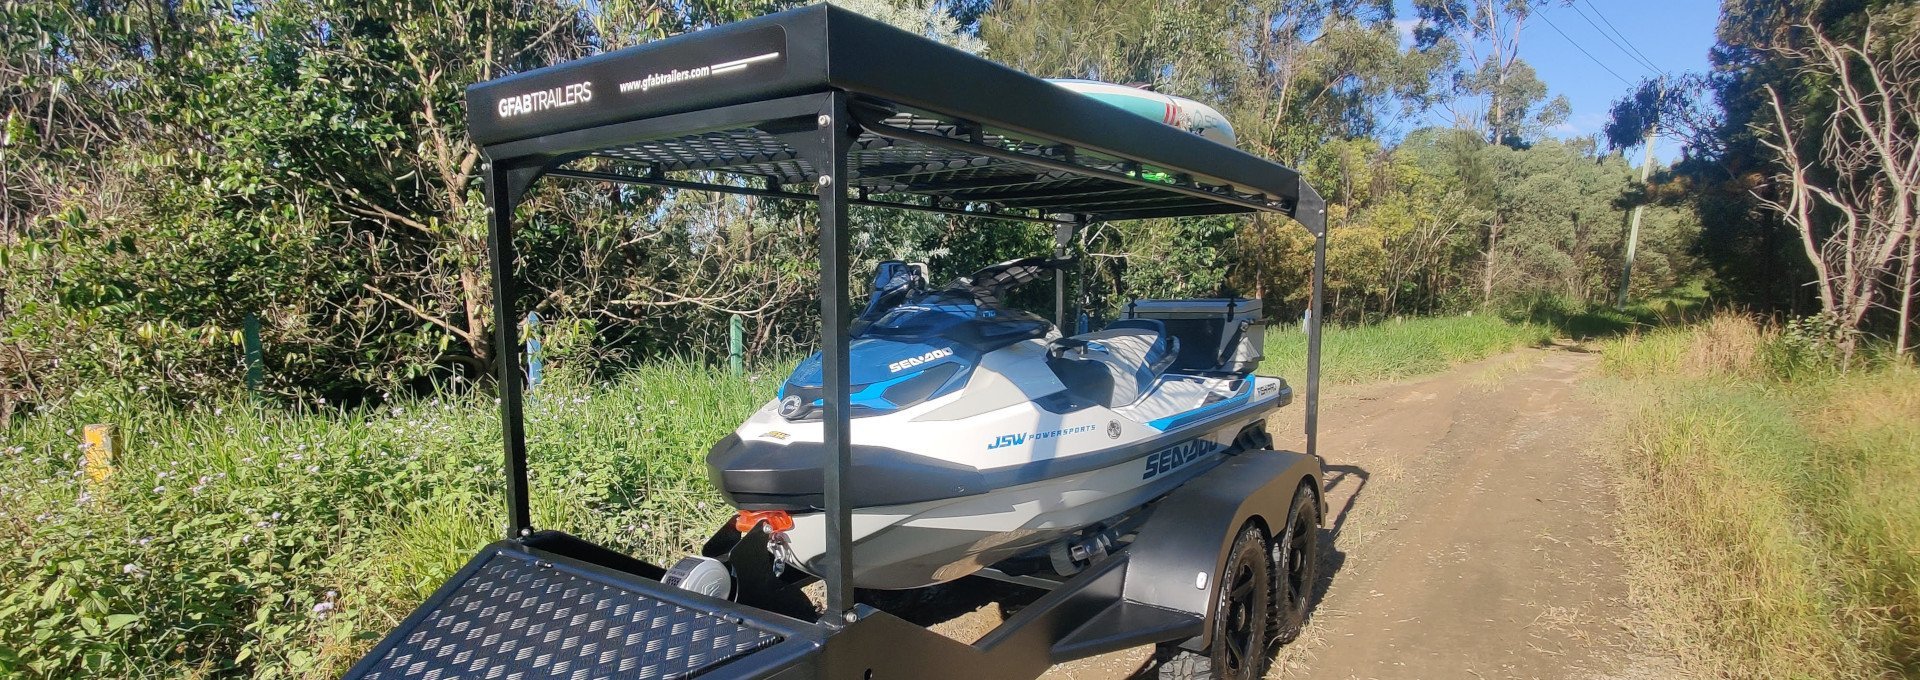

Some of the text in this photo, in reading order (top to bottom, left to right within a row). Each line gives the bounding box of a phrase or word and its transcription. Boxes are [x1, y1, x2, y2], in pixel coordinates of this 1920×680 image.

[619, 66, 710, 92] www.gfabtrailers.com
[498, 81, 592, 118] GFABTRAILERS
[987, 424, 1096, 450] JSW POWERSPORTS
